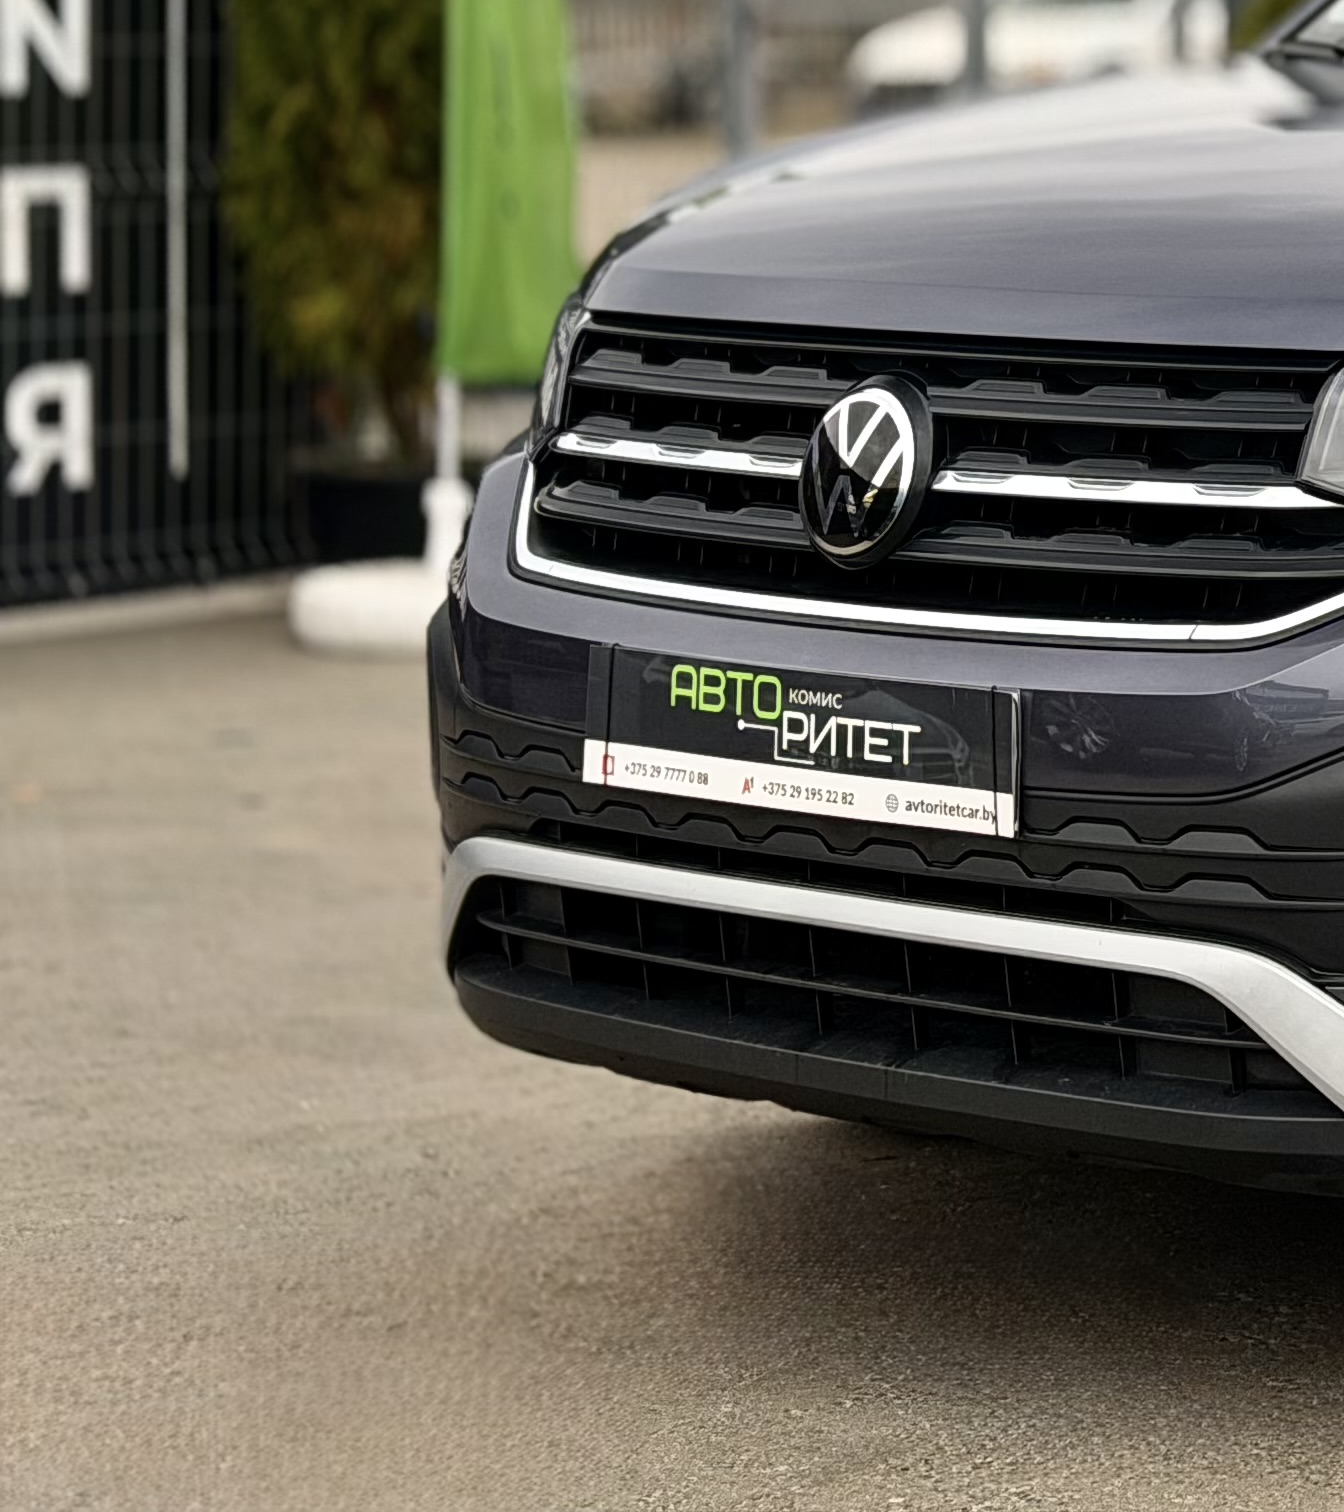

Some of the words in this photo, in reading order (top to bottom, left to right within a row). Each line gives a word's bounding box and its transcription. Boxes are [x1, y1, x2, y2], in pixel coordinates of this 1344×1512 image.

[670, 664, 783, 720] АВТО
[788, 687, 843, 710] КОМИС
[782, 710, 922, 766] РИТЕТ
[624, 761, 648, 777] +375
[650, 764, 662, 779] 29
[664, 766, 687, 783] 7777
[688, 770, 695, 784] 0
[762, 781, 787, 797] +375
[789, 784, 802, 799] 29
[804, 786, 823, 802] 195
[825, 789, 838, 804] 22
[841, 791, 855, 806] 82
[904, 798, 996, 826] avtoritetcar.by
